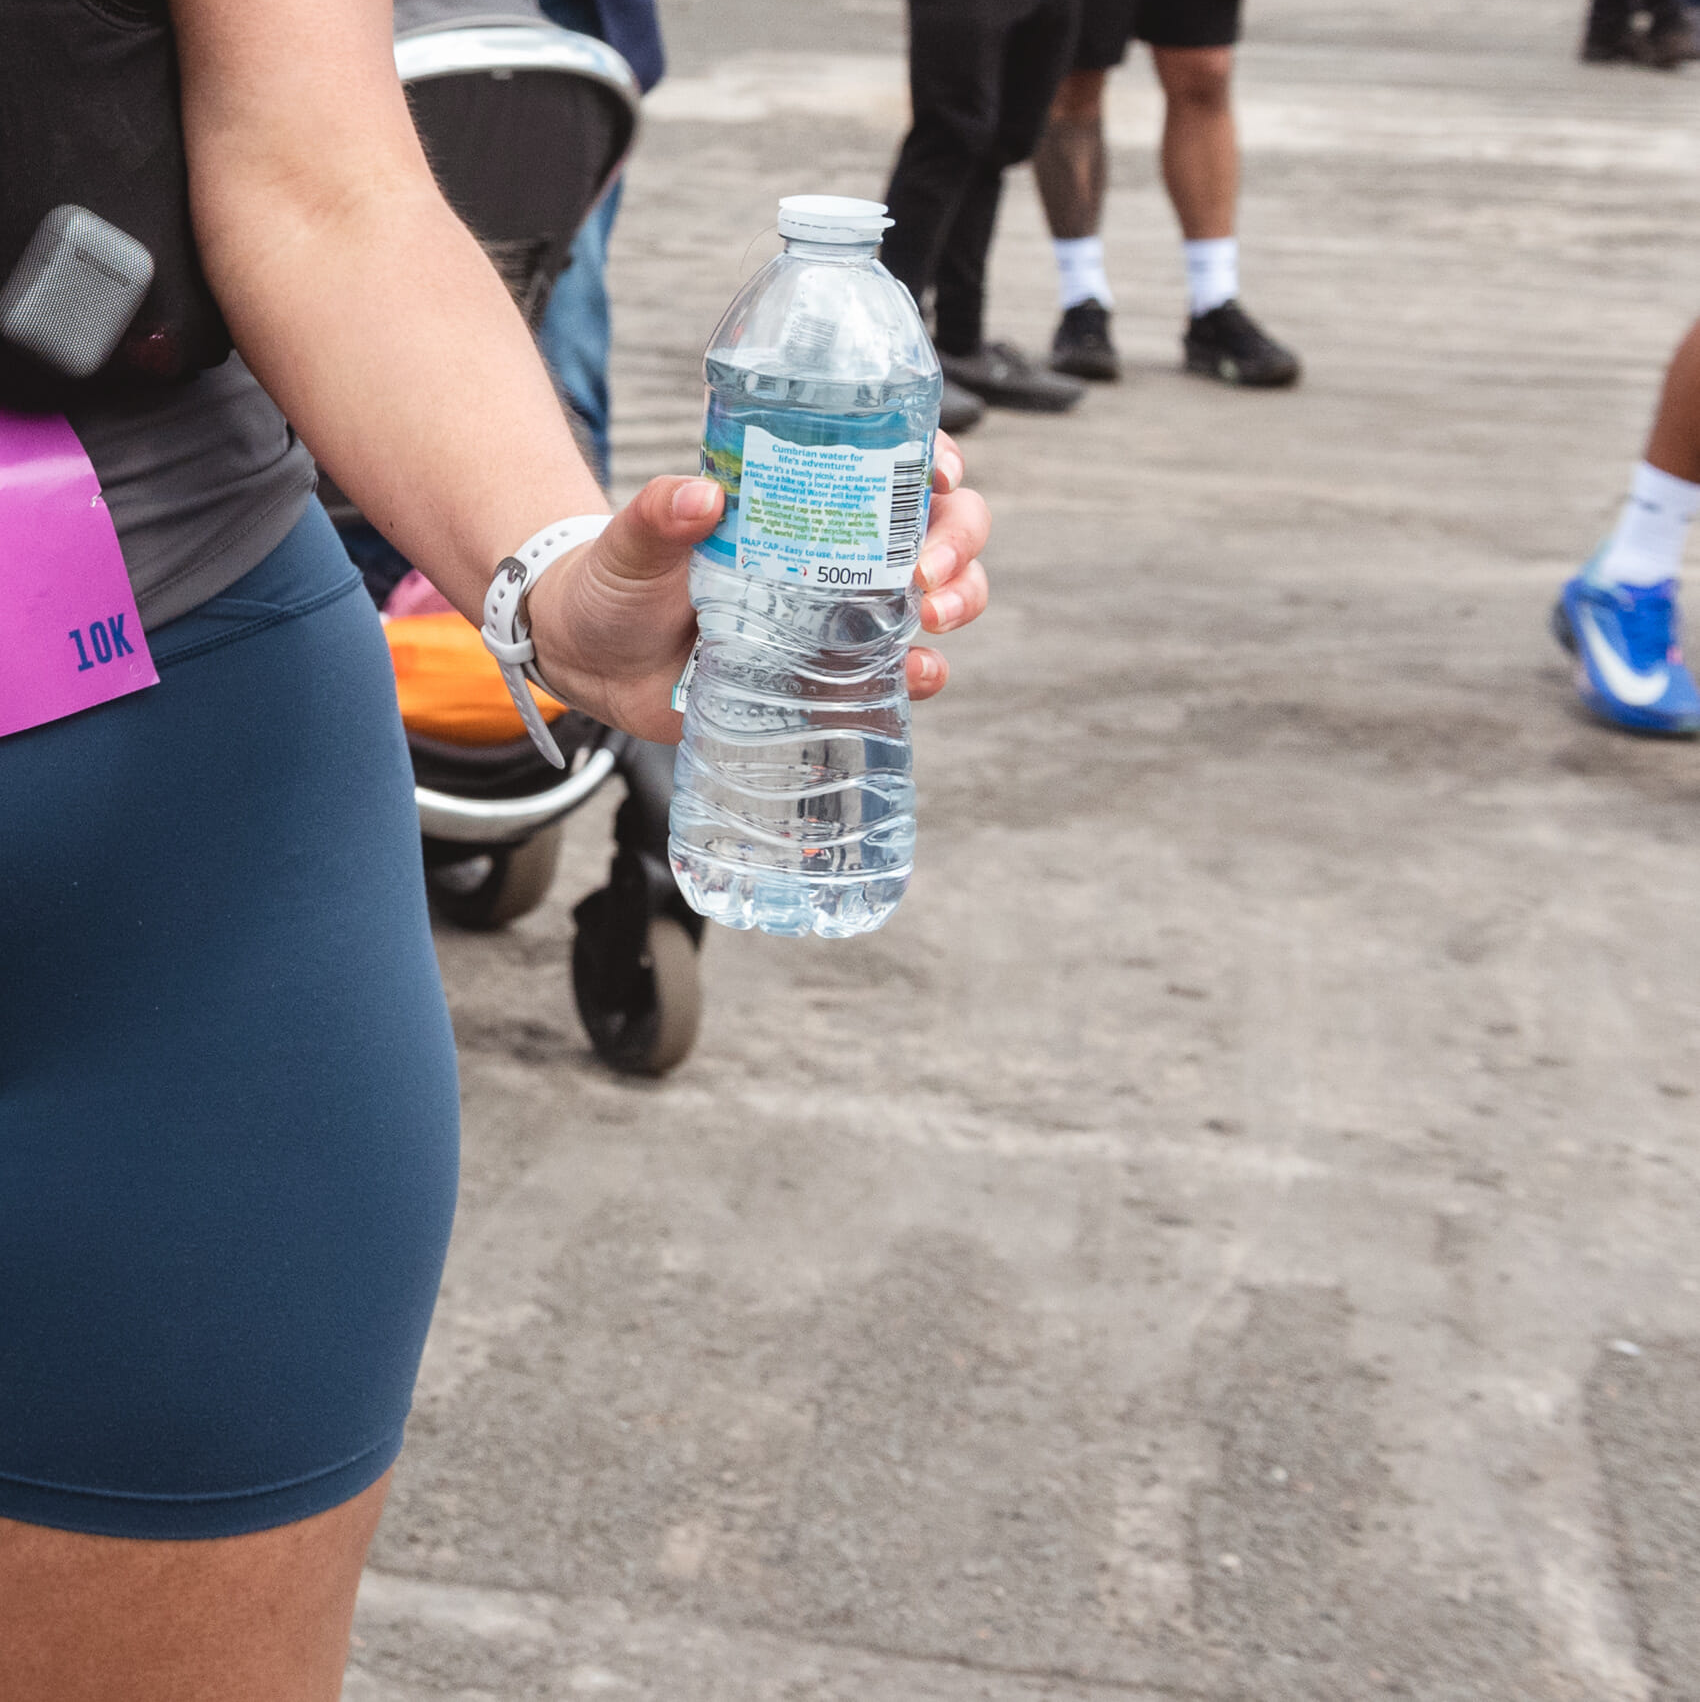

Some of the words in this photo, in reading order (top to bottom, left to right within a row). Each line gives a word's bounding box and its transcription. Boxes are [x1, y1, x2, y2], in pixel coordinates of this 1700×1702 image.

[772, 444, 817, 458] Cumbrian
[819, 452, 848, 461] water
[850, 453, 864, 462] for
[778, 454, 799, 466] life's
[801, 459, 856, 471] adventures
[807, 489, 828, 497] Water
[740, 536, 761, 547] SNAP
[762, 541, 779, 550] CAP
[784, 545, 803, 557] Easy
[835, 551, 856, 560] hard
[857, 553, 866, 561] to
[866, 553, 883, 561] lose
[816, 566, 873, 585] 500ml
[69, 613, 135, 673] 10K
